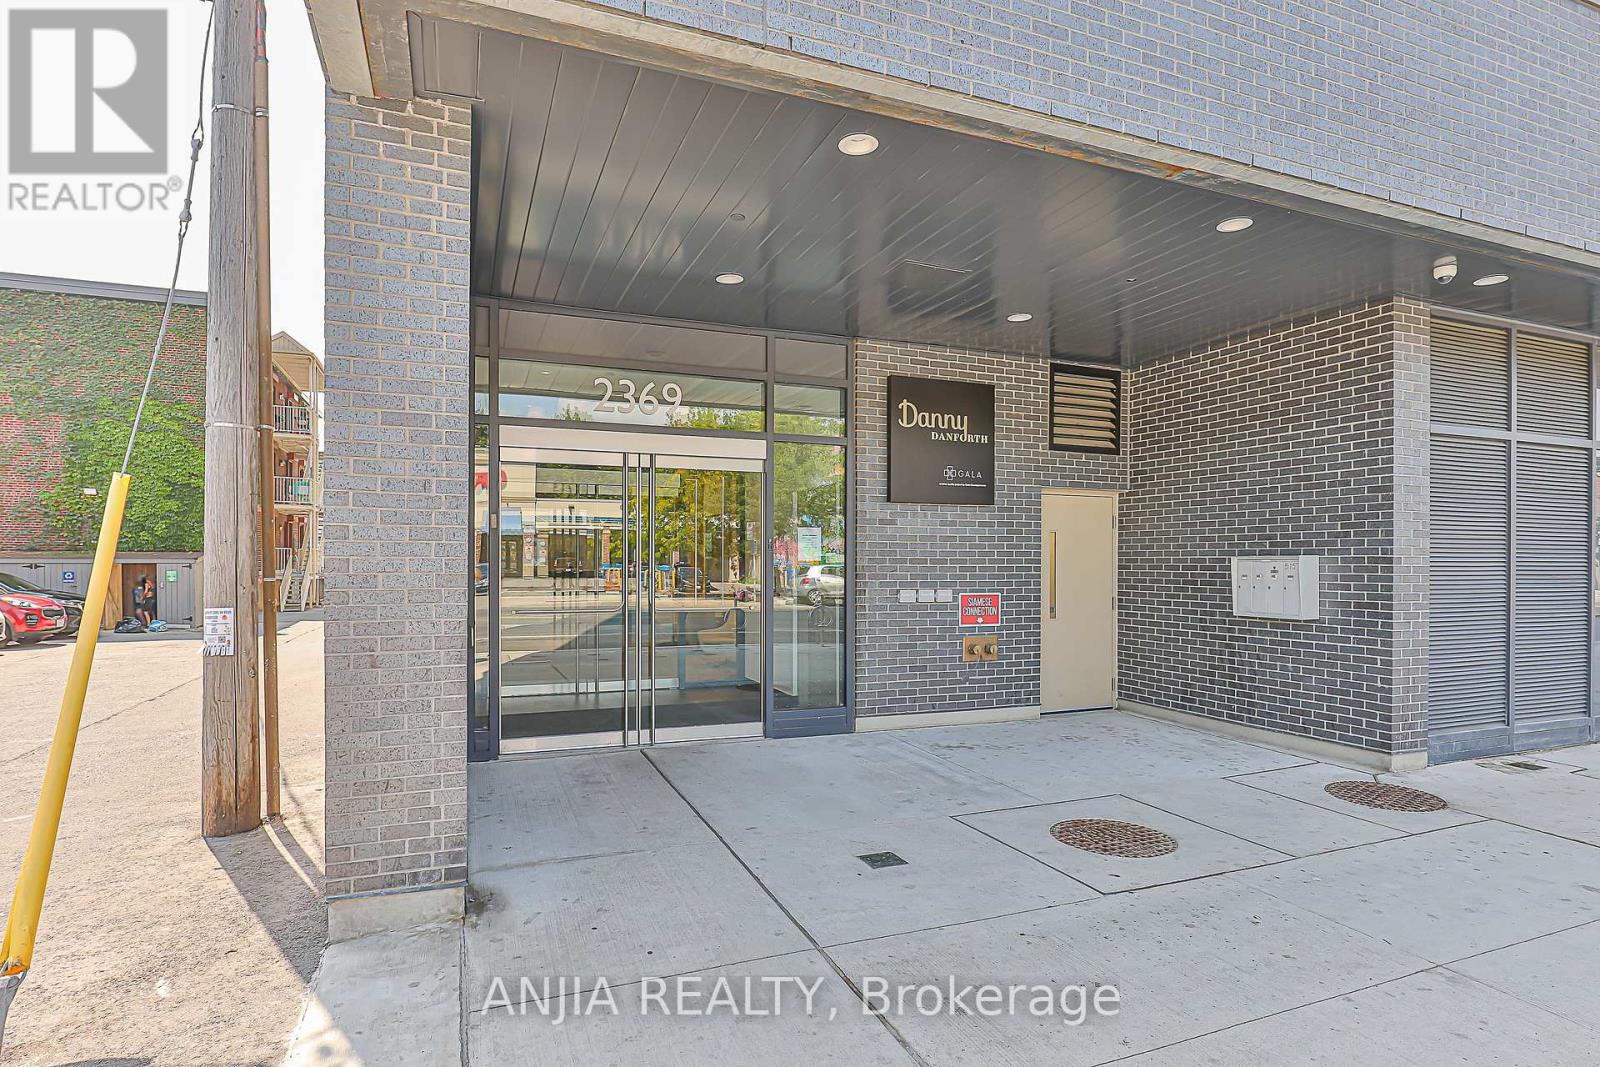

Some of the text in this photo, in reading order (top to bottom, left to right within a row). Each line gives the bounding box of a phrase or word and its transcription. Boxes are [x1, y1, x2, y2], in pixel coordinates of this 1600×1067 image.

[593, 377, 682, 424] 2369
[898, 399, 968, 441] Danny
[931, 431, 988, 444] DANFORTH
[957, 469, 982, 479] GALA
[967, 597, 993, 607] SIAMESE
[962, 606, 998, 616] CONNECTION
